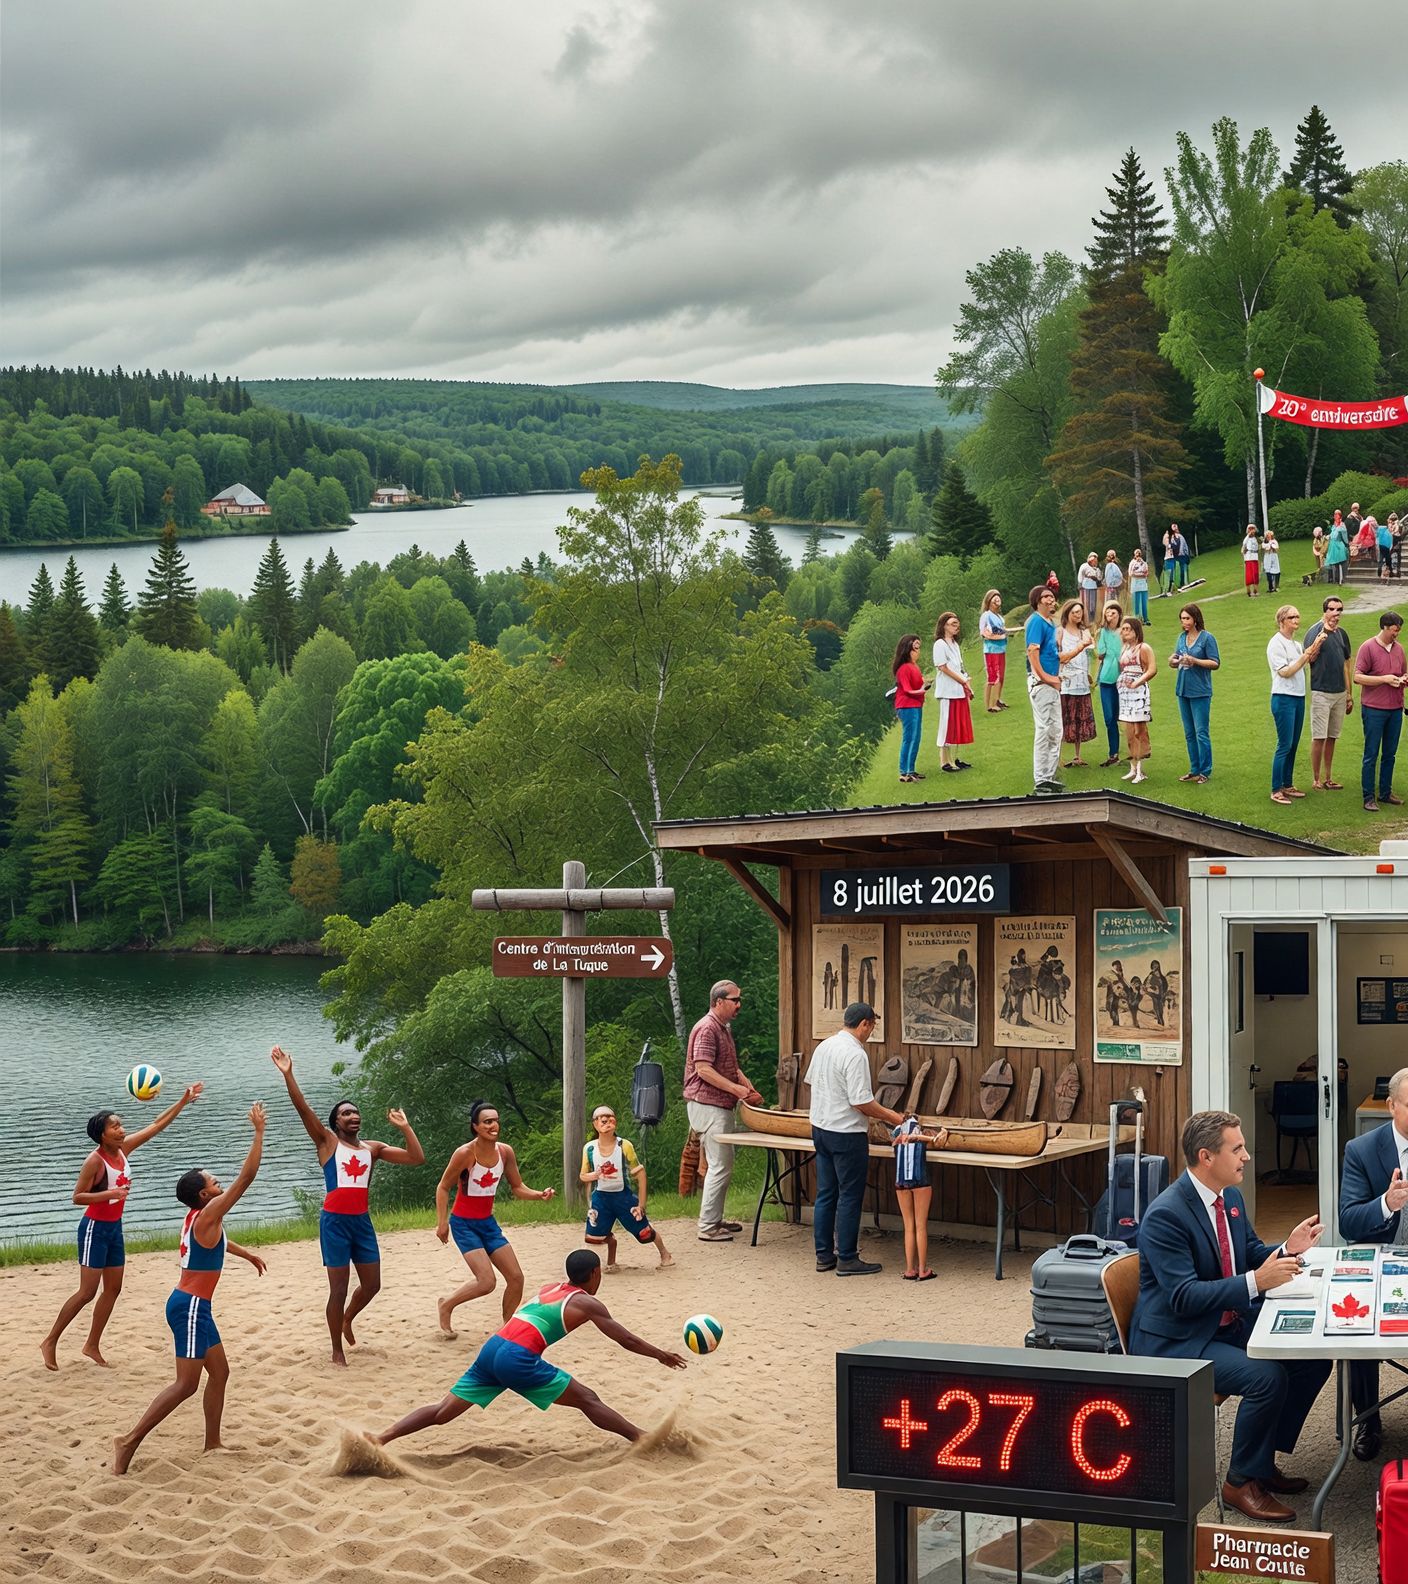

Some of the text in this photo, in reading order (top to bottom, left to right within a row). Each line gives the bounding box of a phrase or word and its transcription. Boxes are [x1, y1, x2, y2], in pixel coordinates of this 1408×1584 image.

[833, 874, 995, 912] 8 juillet 2026
[497, 941, 538, 955] Centre
[533, 959, 548, 971] de
[883, 1389, 1132, 1480] +27 C
[1213, 1532, 1311, 1559] Pharmacie
[1210, 1551, 1250, 1569] Jean
